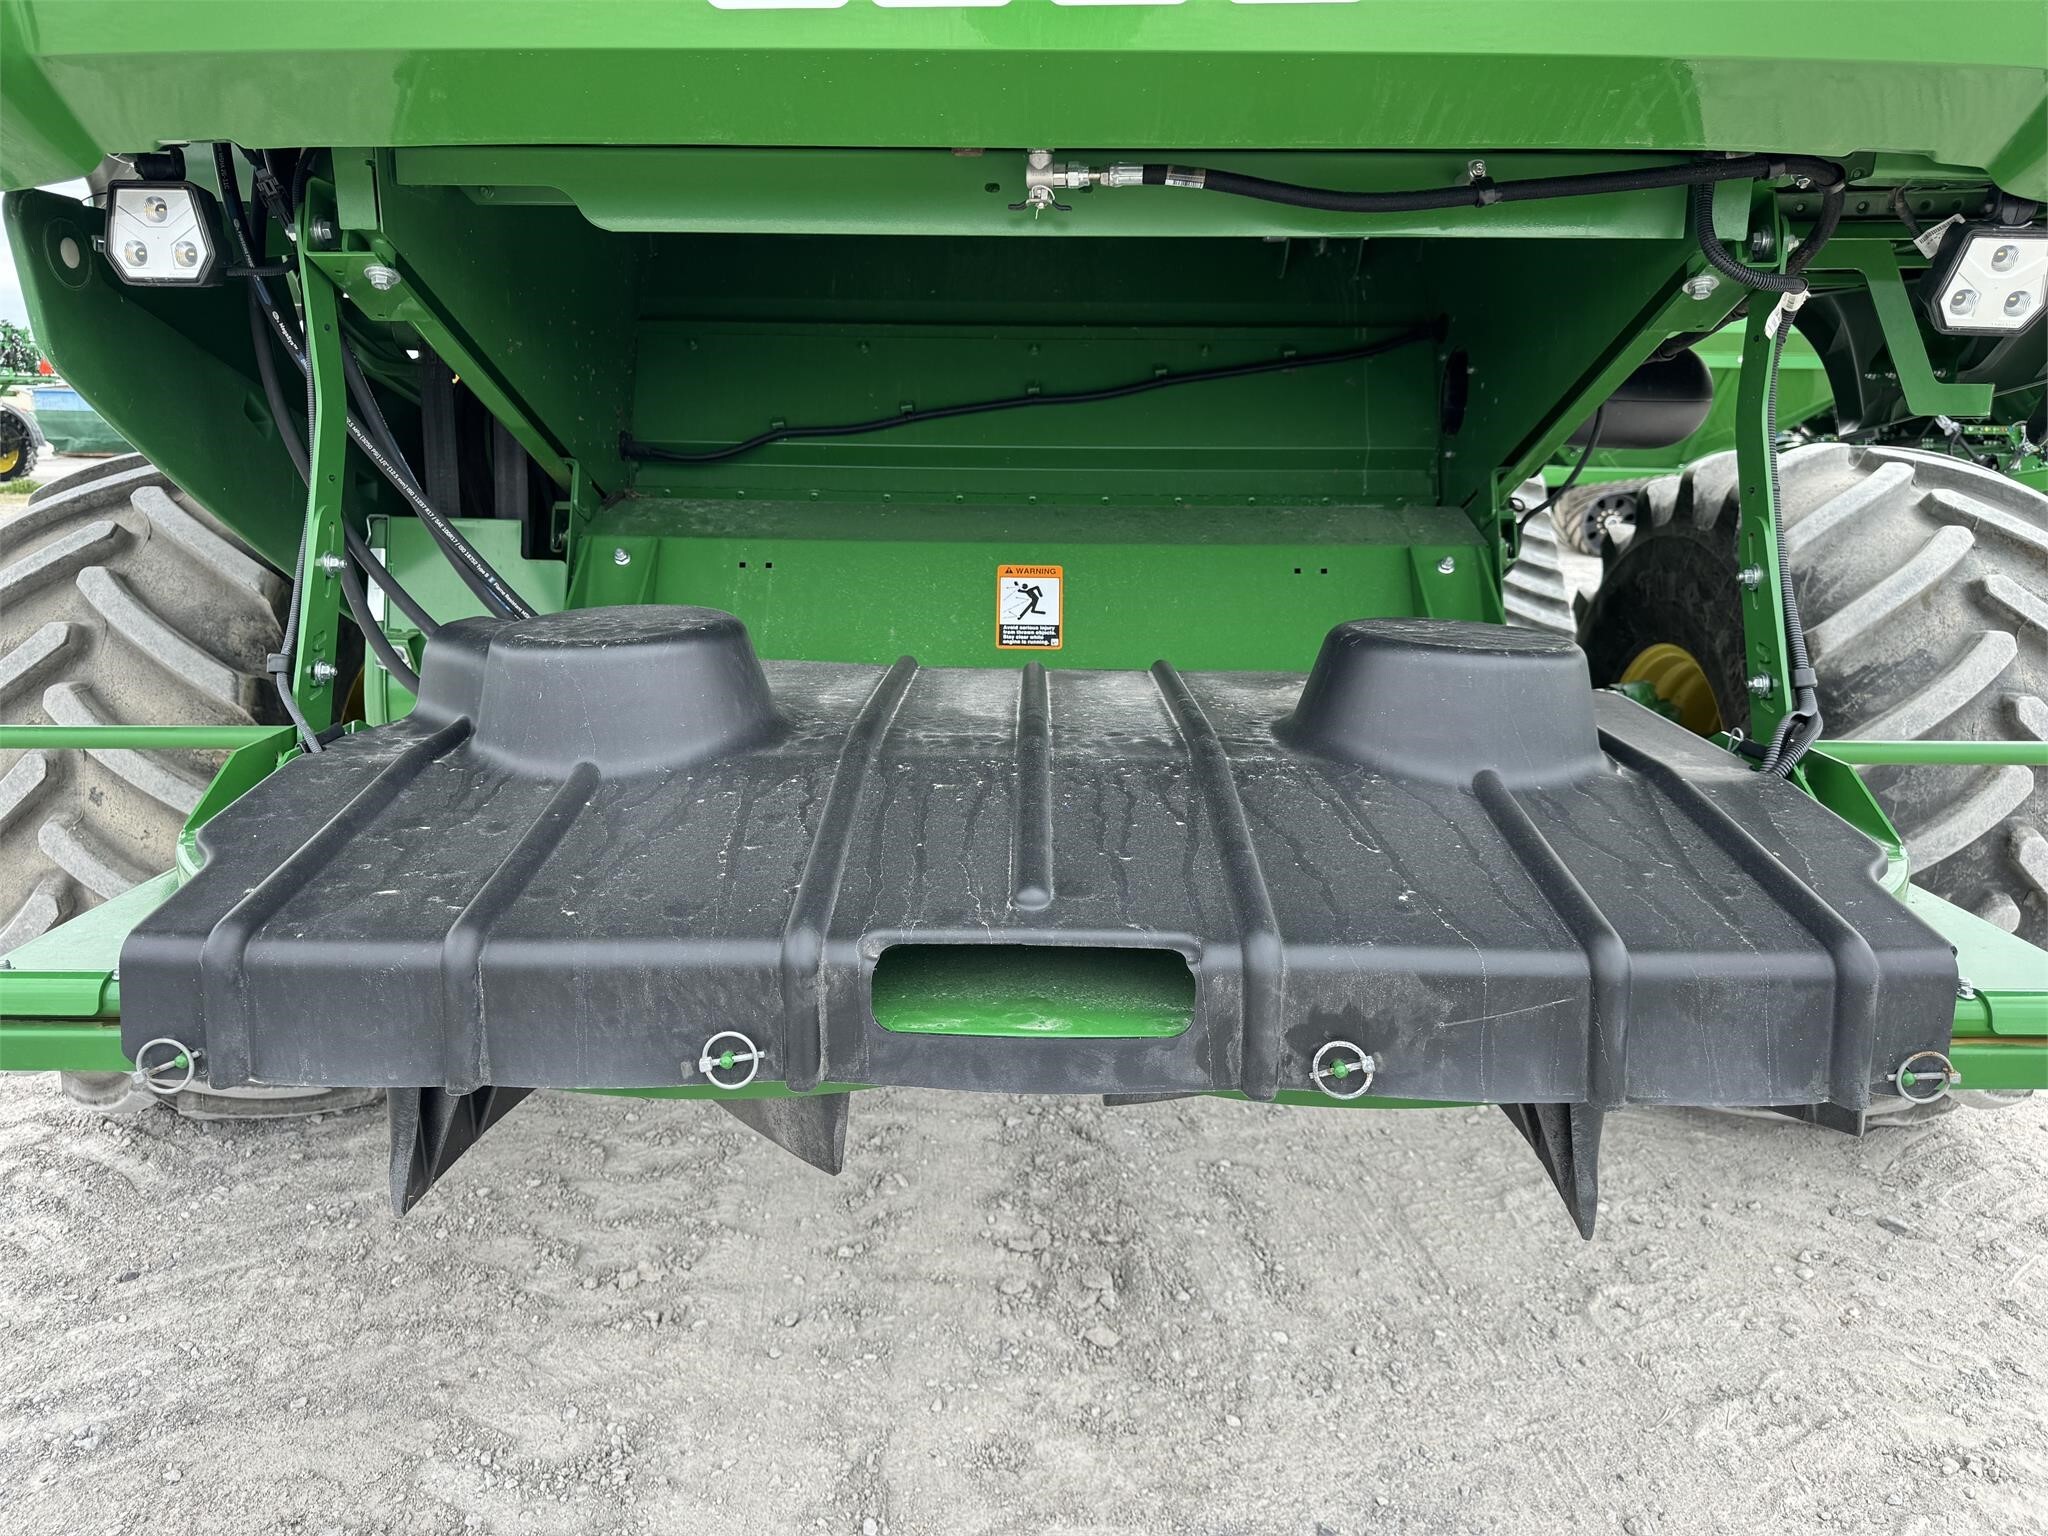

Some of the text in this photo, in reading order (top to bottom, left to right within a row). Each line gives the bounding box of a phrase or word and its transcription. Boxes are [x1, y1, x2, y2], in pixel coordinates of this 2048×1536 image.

[406, 487, 415, 496] ISO
[412, 494, 427, 508] 11237
[424, 507, 434, 517] R17
[434, 518, 444, 528] SAE
[441, 526, 458, 543] 100R17
[464, 551, 478, 565] 18752
[476, 563, 485, 574] Type
[493, 582, 506, 595] Flame
[504, 593, 522, 612] Resistant
